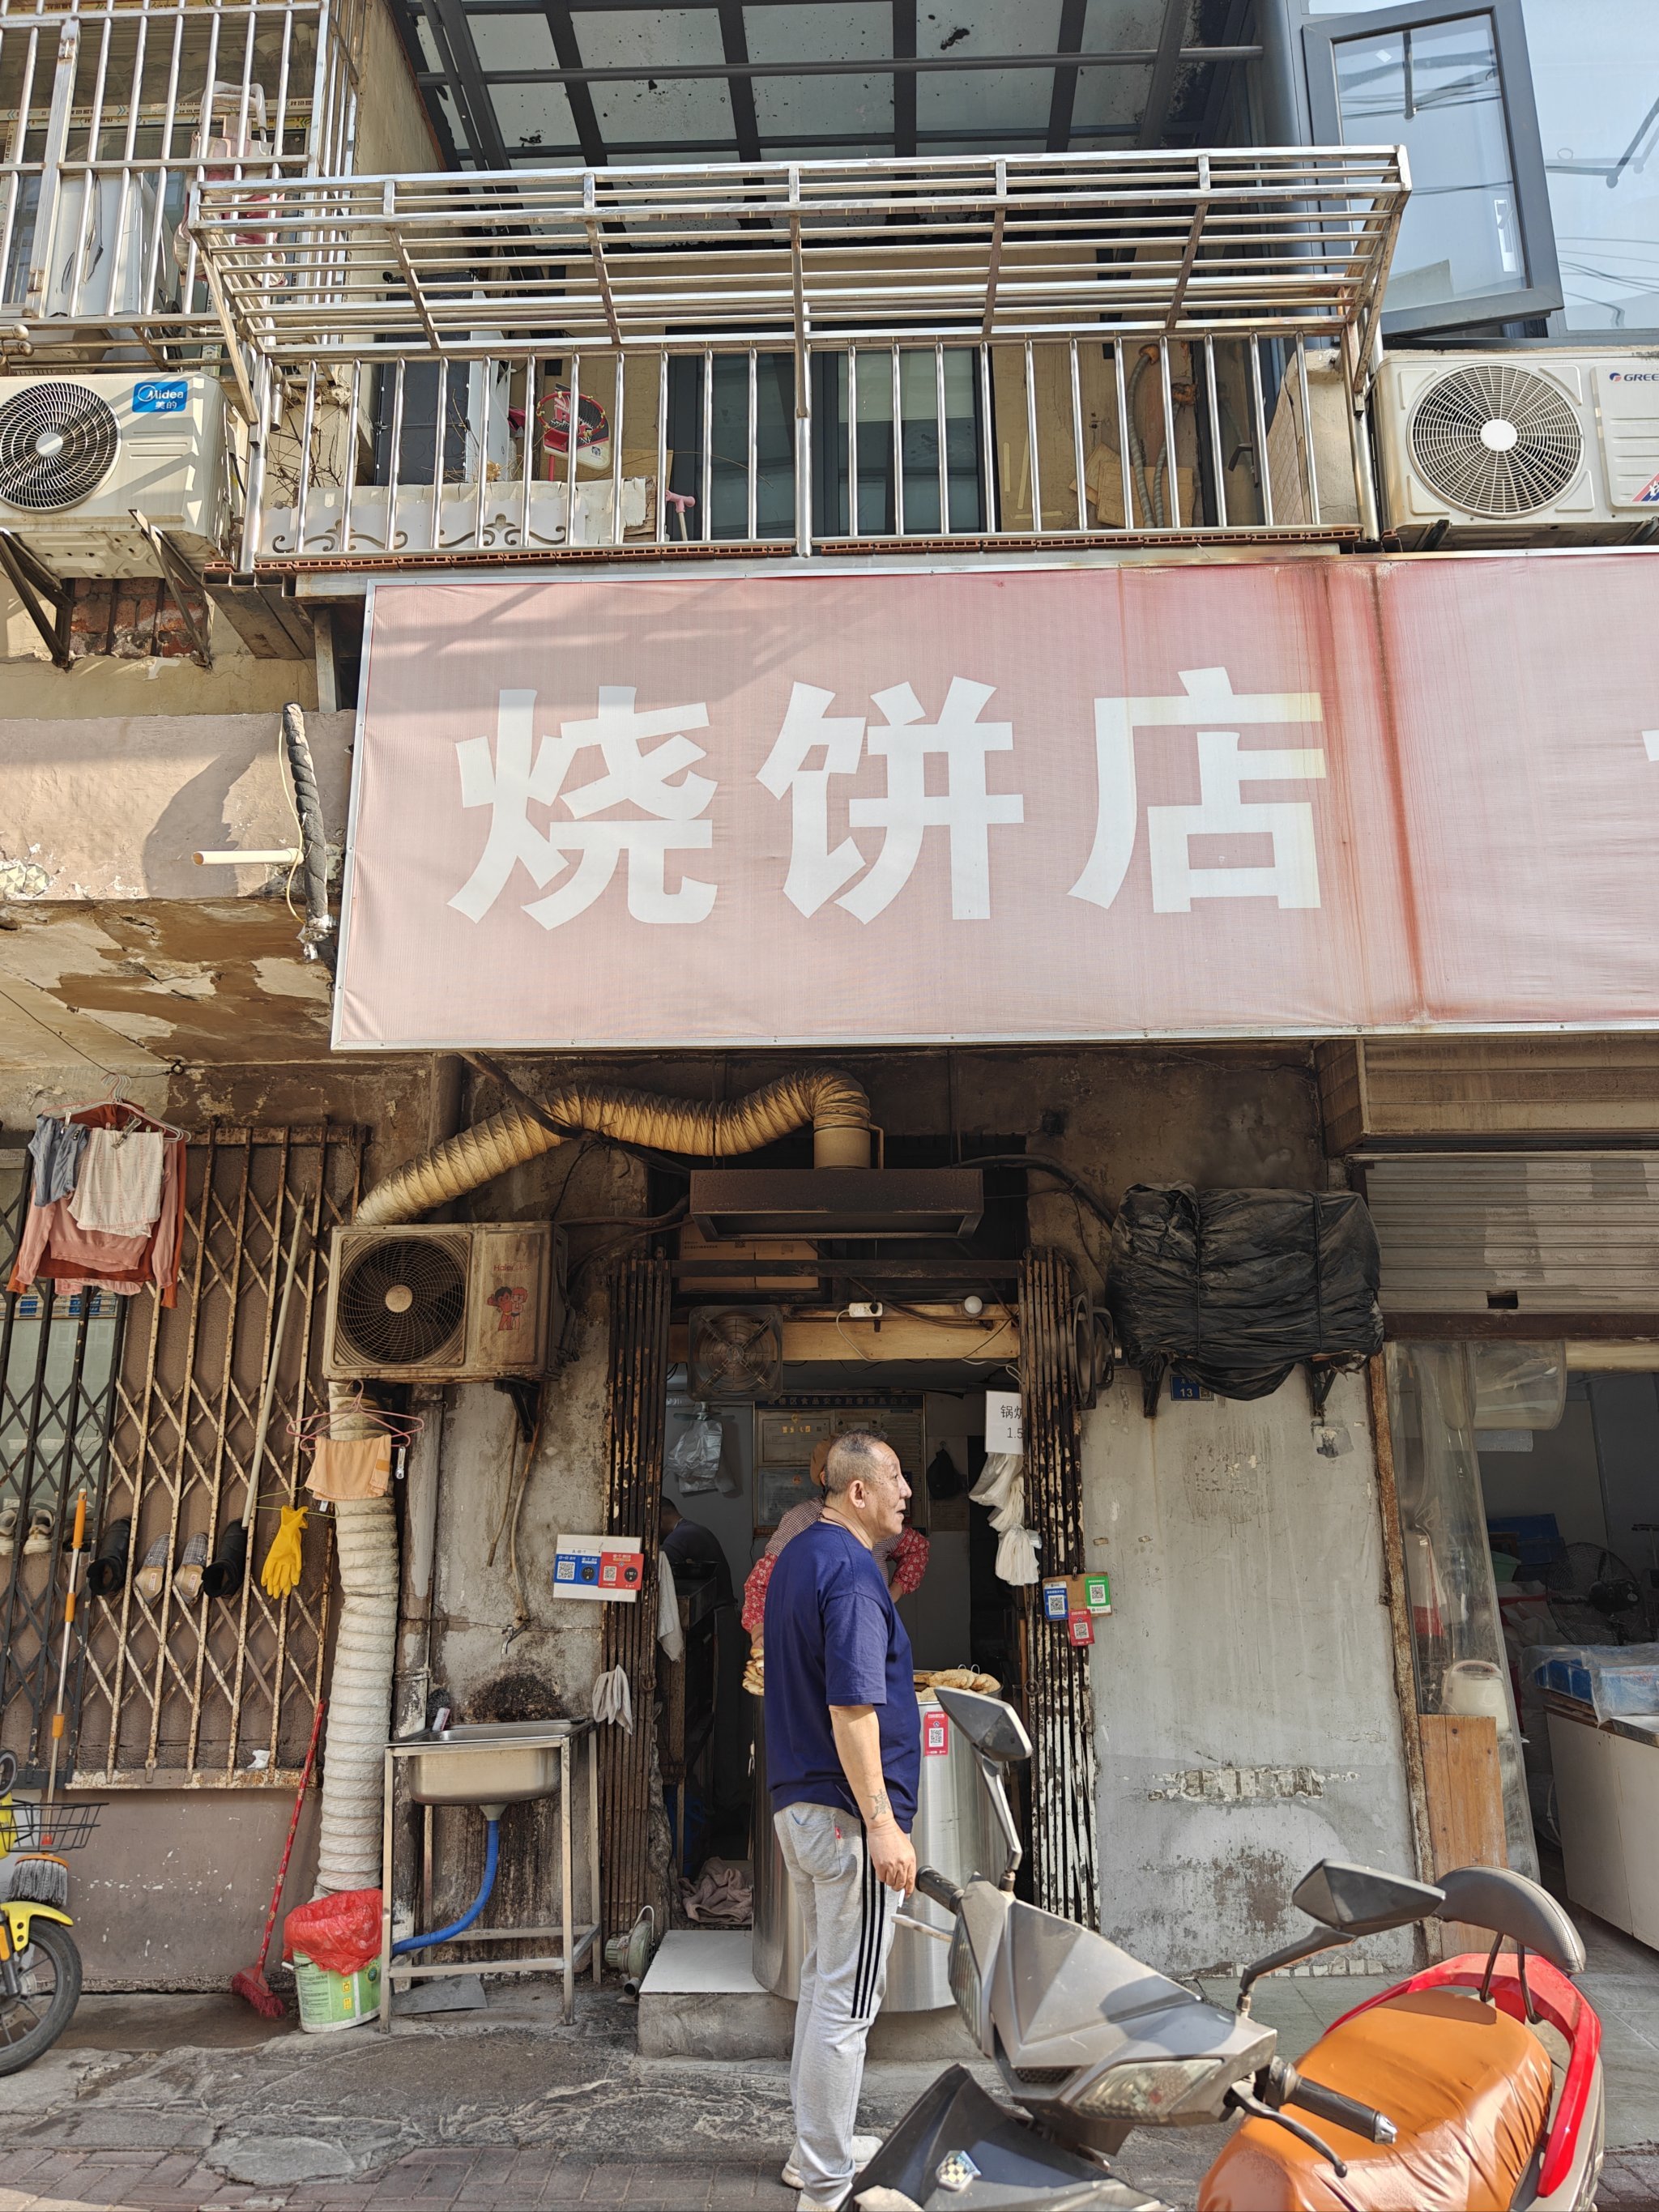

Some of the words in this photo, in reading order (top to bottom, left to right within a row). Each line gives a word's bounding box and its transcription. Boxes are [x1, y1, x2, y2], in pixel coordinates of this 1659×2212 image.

[1623, 373, 1659, 381] GREE
[141, 387, 184, 400] Midea
[155, 401, 177, 409] 美的
[446, 667, 1326, 931] 烧饼店
[1179, 1387, 1193, 1398] 13
[1007, 1427, 1024, 1439] 1.5
